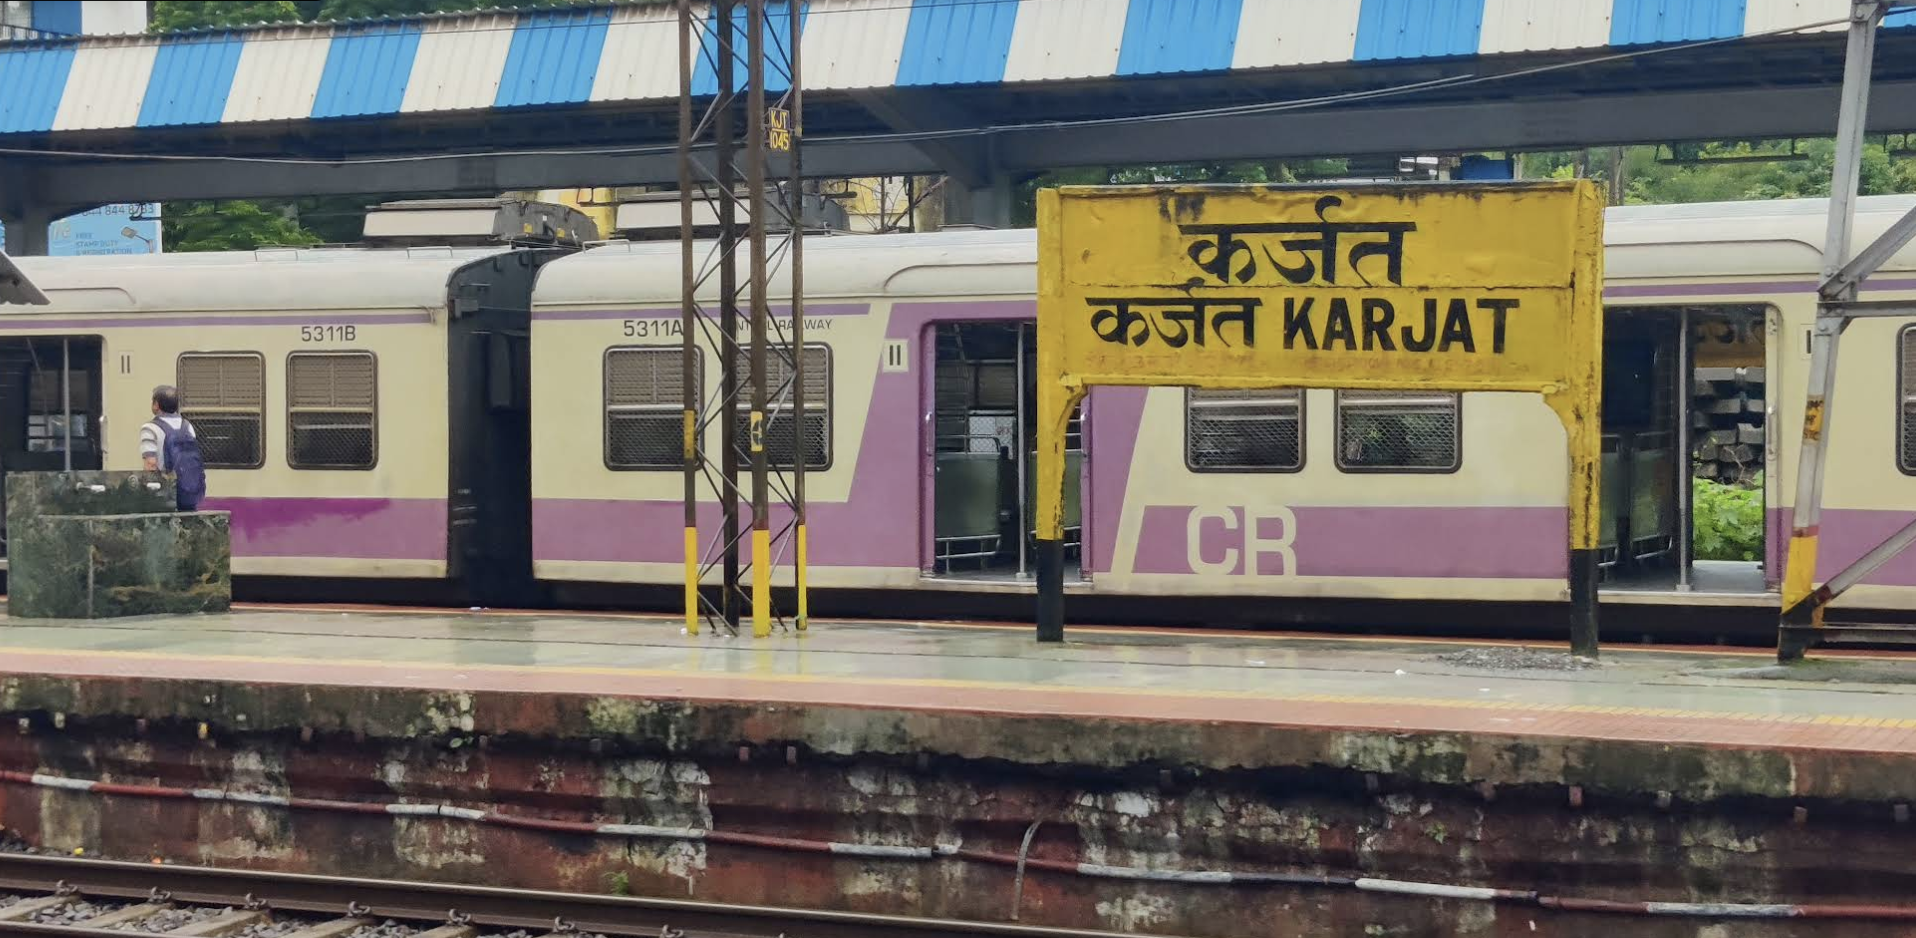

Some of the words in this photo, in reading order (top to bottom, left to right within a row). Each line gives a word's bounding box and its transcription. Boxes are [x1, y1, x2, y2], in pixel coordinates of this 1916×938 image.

[771, 110, 787, 129] KJT
[770, 131, 789, 150] 1045
[1178, 195, 1417, 287] कर्जत
[1085, 277, 1263, 348] कर्जत
[301, 325, 356, 342] 5311B
[623, 319, 684, 337] 5311A
[779, 319, 833, 330] RAWAY
[1283, 297, 1520, 354] KARJAT
[1187, 504, 1297, 576] CR
